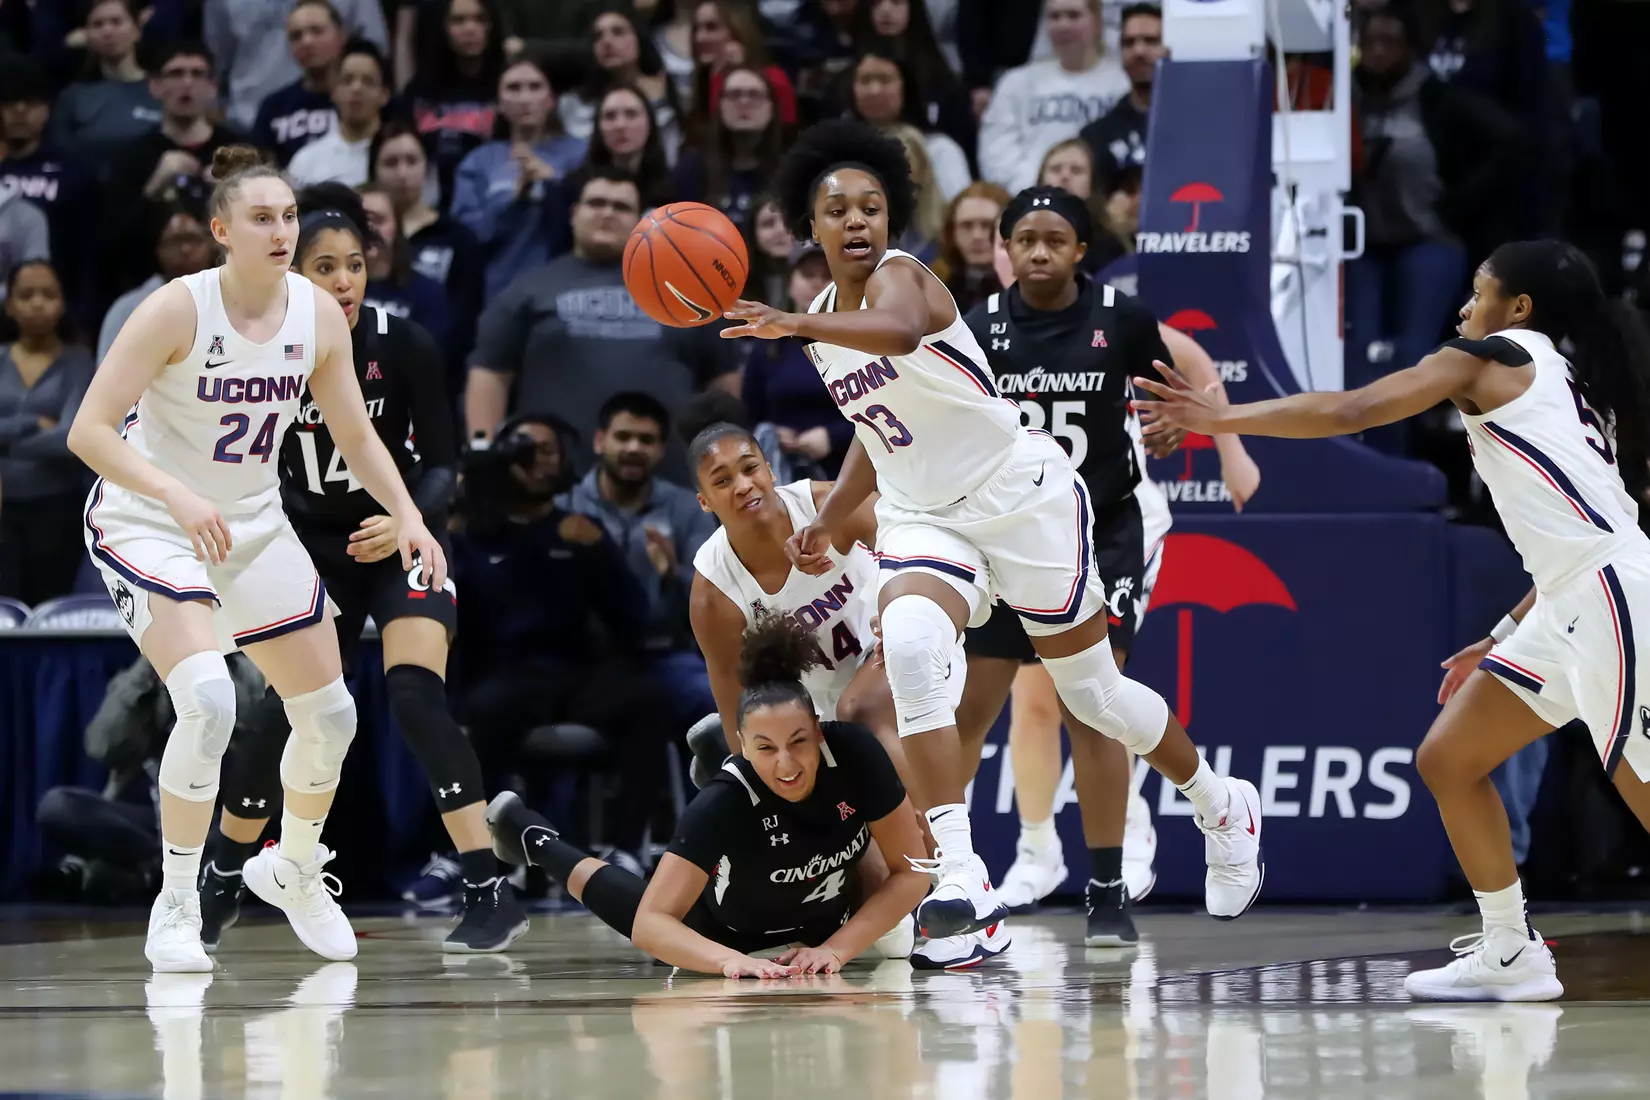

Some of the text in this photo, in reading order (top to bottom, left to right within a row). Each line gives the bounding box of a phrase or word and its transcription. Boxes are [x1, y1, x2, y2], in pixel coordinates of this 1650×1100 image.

[1136, 231, 1251, 254] TRAVELERS
[990, 322, 1007, 335] RJ
[196, 374, 304, 404] UCONN
[828, 355, 899, 407] CONN
[997, 366, 1105, 394] CINCINNATI
[212, 412, 280, 464] 24
[850, 404, 913, 454] 13
[295, 431, 364, 496] 14
[762, 814, 779, 831] RJ
[769, 821, 869, 883] CINCINNATI
[801, 868, 846, 904] 4
